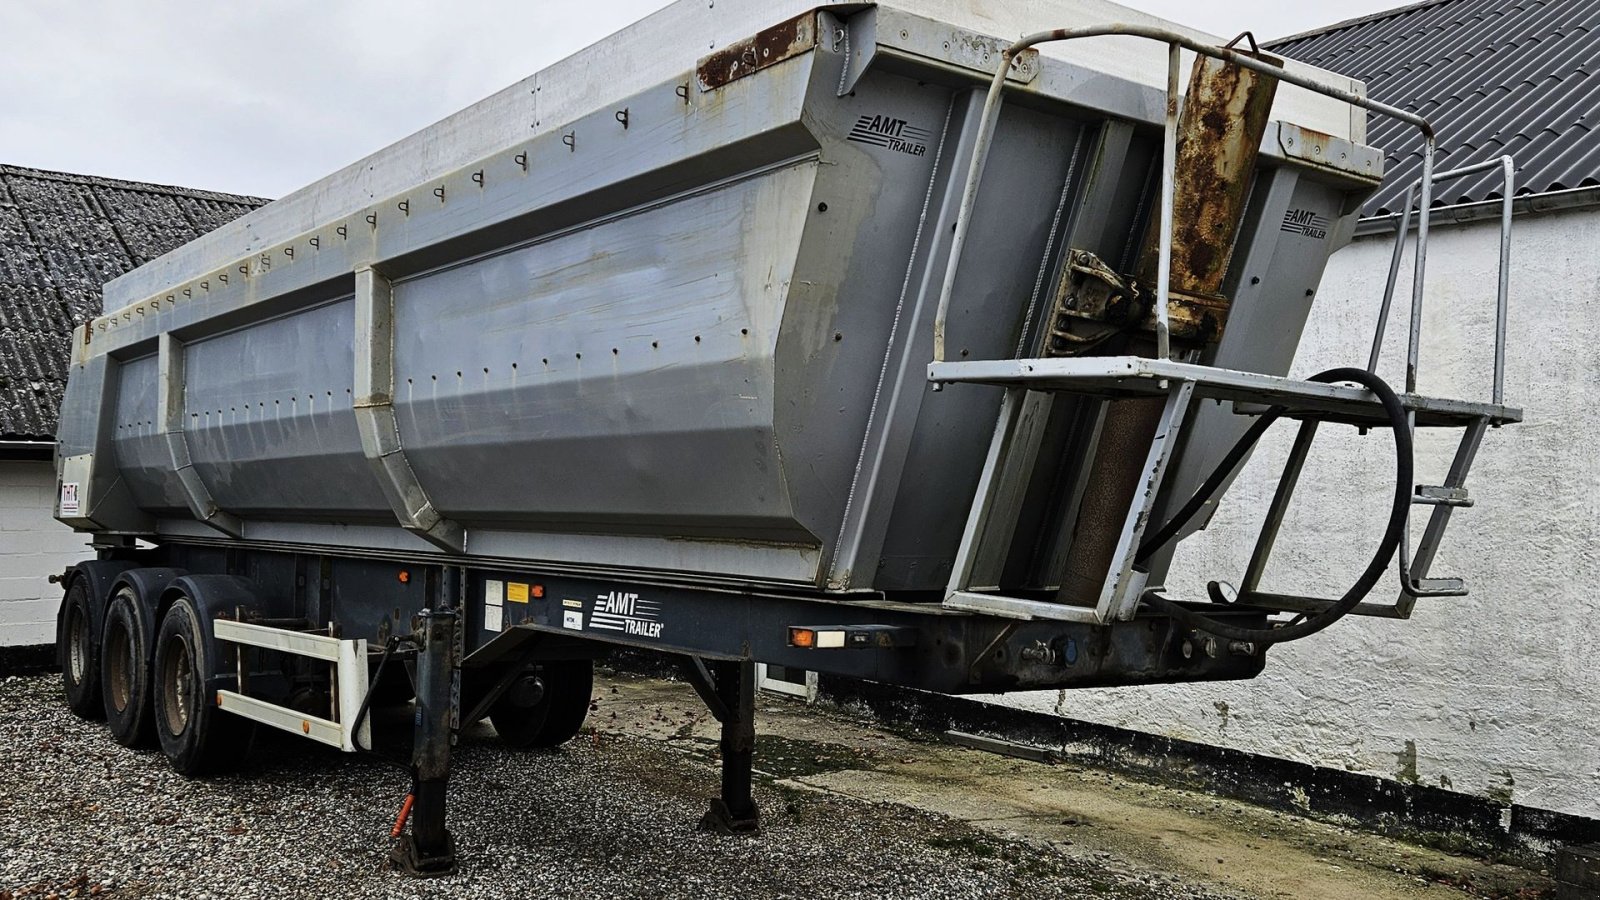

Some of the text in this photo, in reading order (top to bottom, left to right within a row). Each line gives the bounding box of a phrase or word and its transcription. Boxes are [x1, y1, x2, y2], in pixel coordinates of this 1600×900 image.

[868, 114, 907, 137] AMT
[887, 139, 926, 157] TRAILER
[1289, 209, 1316, 225] AMT
[1301, 227, 1326, 240] TRAILER
[605, 591, 638, 615] AMT
